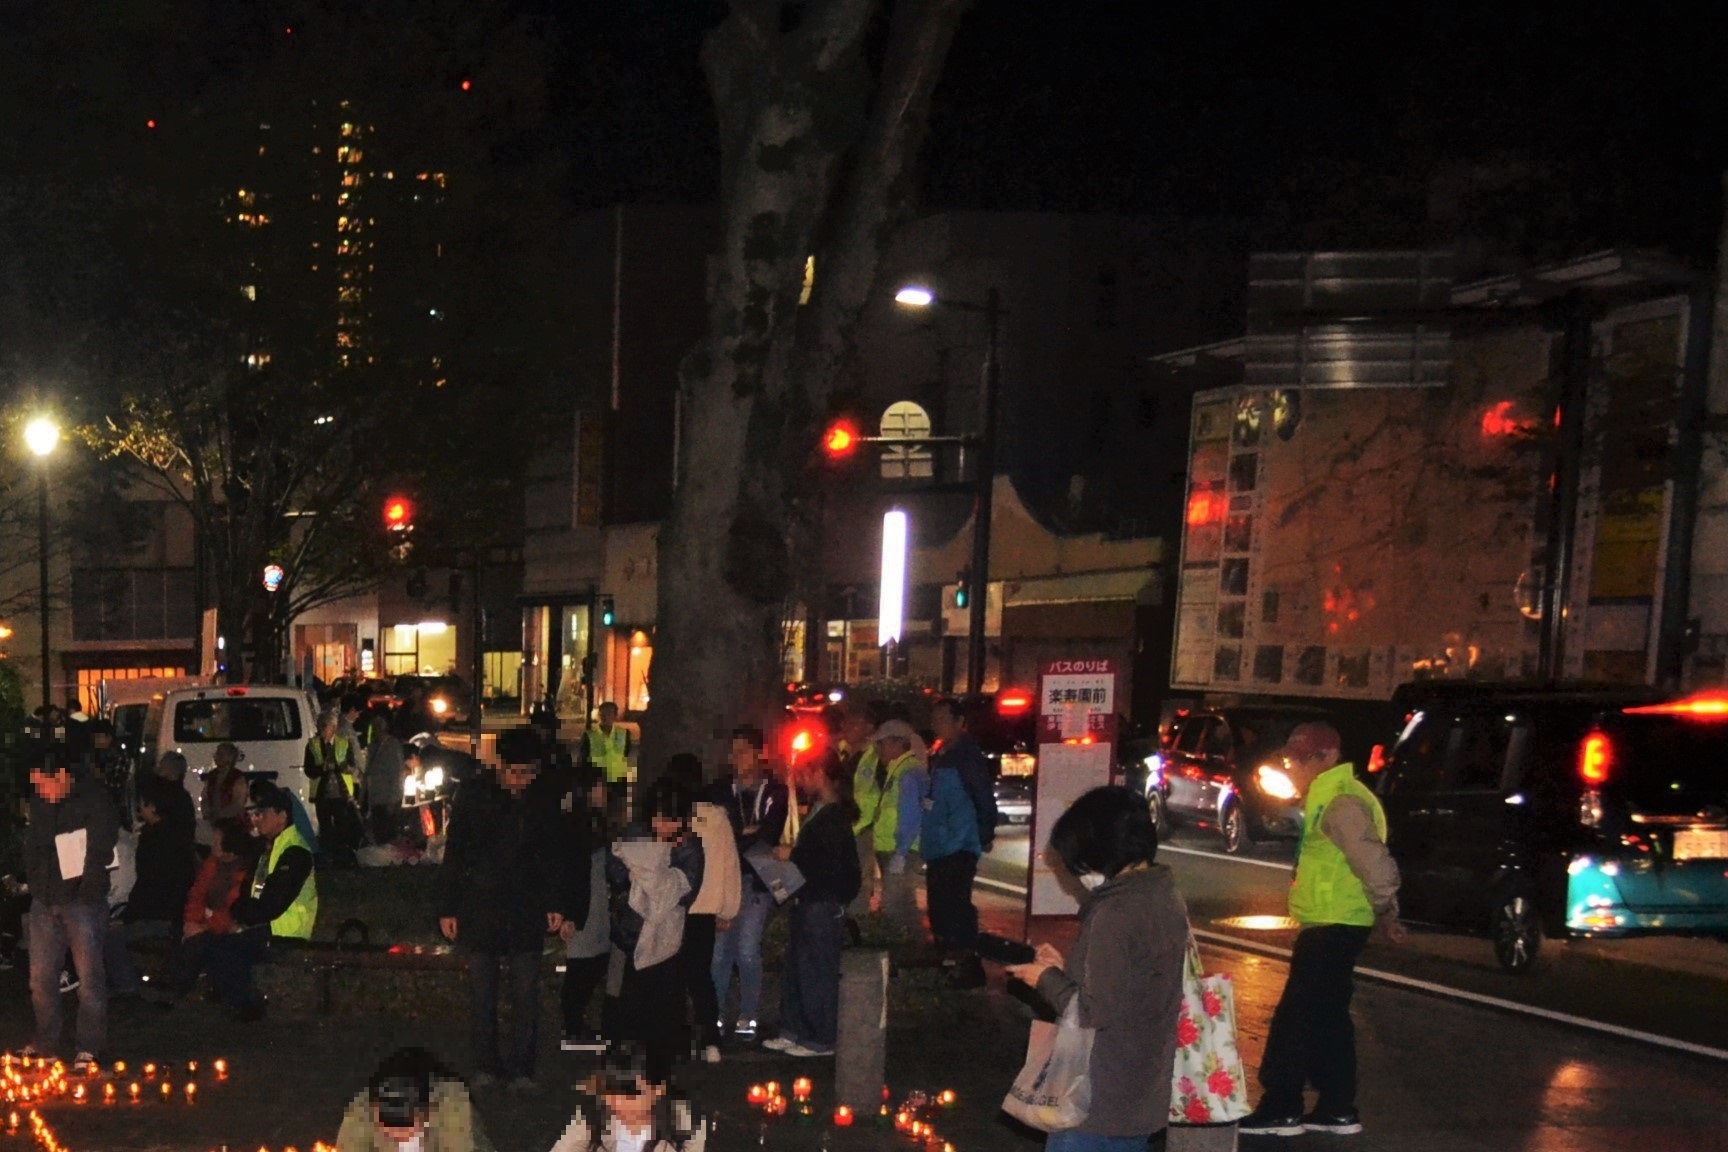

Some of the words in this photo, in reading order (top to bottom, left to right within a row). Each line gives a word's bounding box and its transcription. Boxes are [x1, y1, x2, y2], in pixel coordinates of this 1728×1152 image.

[1050, 661, 1108, 673] バスのりば
